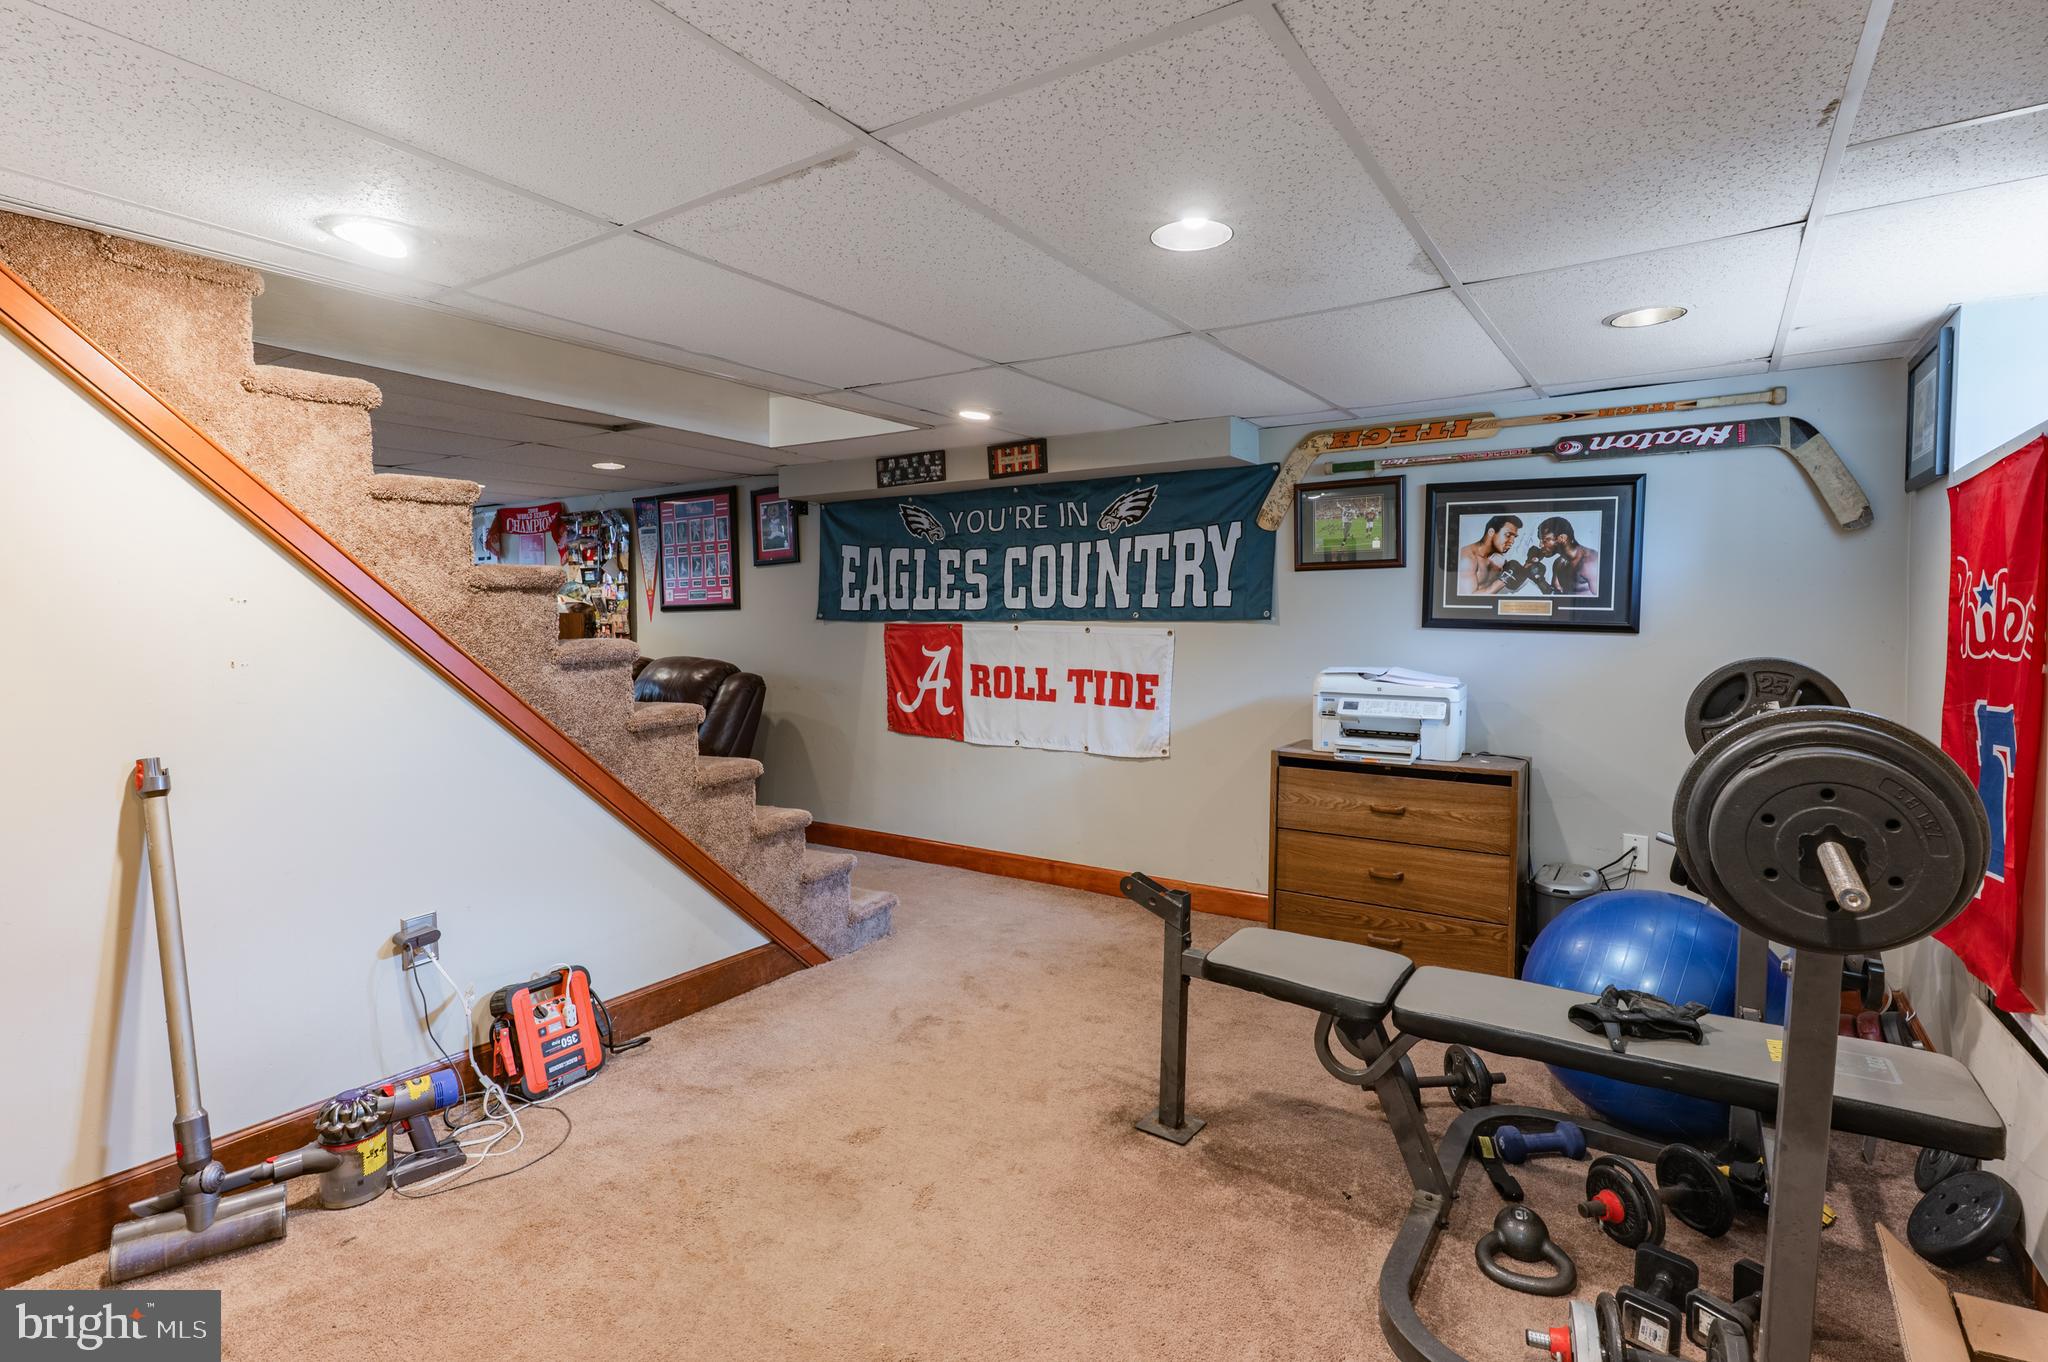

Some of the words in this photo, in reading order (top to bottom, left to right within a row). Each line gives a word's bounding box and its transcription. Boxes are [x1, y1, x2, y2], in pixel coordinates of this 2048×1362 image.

[1328, 419, 1473, 450] ITECH
[1588, 425, 1734, 451] Heaton
[949, 504, 1048, 534] YOU'RE
[1059, 502, 1088, 529] IN
[840, 544, 989, 611] EAGLES
[1002, 521, 1243, 610] COUNTRY
[970, 664, 1057, 703] ROLL
[1066, 669, 1160, 711] TIDE
[1759, 674, 1790, 696] 25
[561, 1034, 578, 1047] 350
[1514, 1210, 1529, 1220] 10
